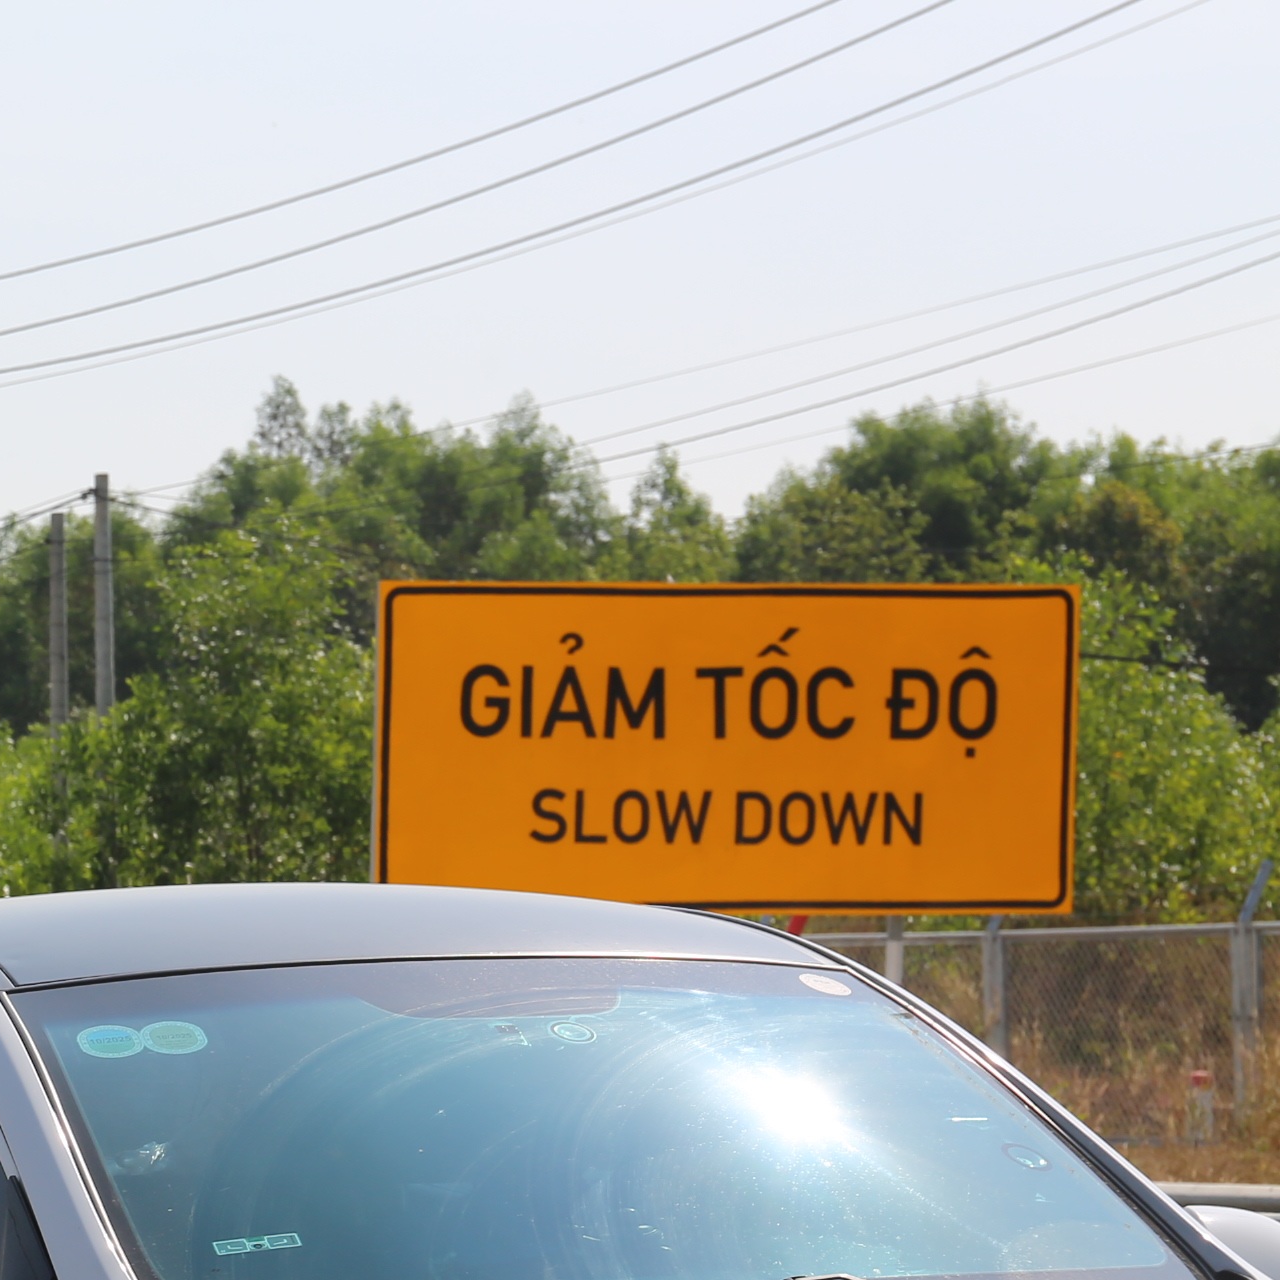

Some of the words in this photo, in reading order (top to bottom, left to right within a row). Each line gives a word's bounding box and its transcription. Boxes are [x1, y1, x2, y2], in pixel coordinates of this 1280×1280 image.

[461, 631, 666, 739] GIẢM
[696, 627, 856, 741] TỐC
[885, 645, 998, 758] ĐỘ
[529, 788, 713, 844] SLOW
[734, 790, 924, 846] DOWN
